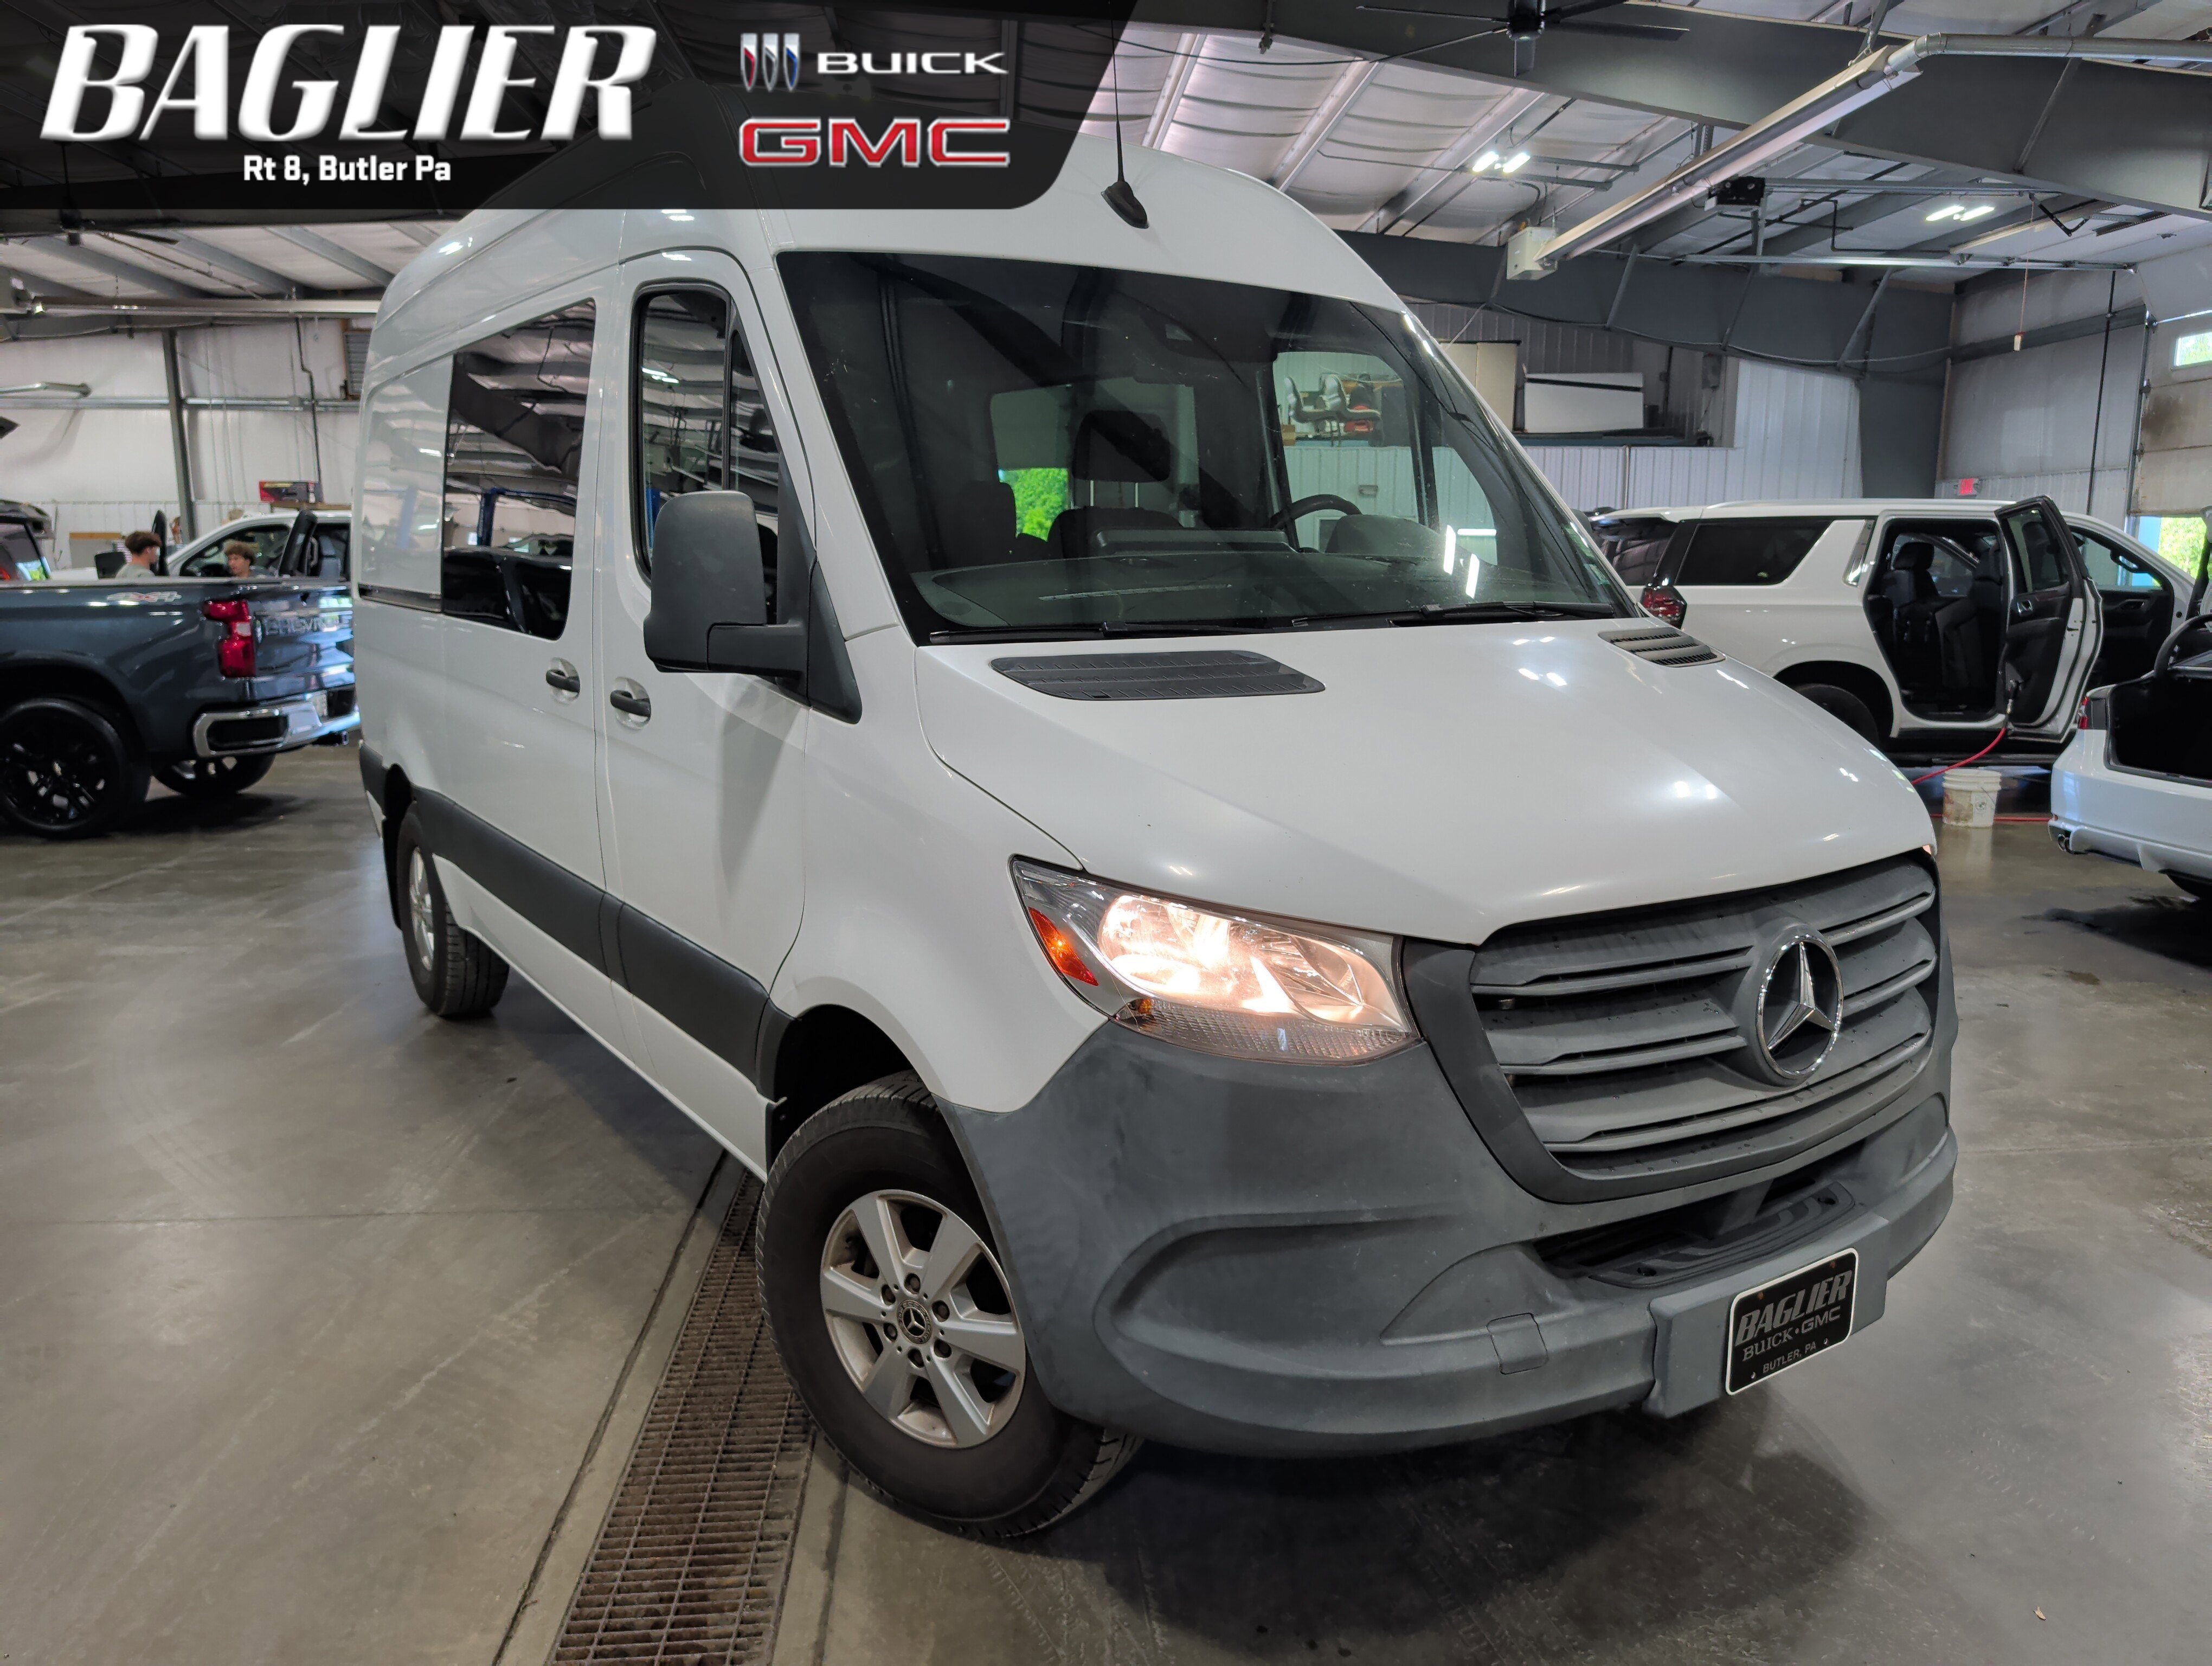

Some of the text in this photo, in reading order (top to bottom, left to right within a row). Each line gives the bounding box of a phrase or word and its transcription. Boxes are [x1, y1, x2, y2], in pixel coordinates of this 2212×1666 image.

[1735, 1270, 1852, 1347] BAGLIER
[1742, 1306, 1841, 1362] BUICK GMC
[1762, 1341, 1816, 1373] BUTLER, PA
